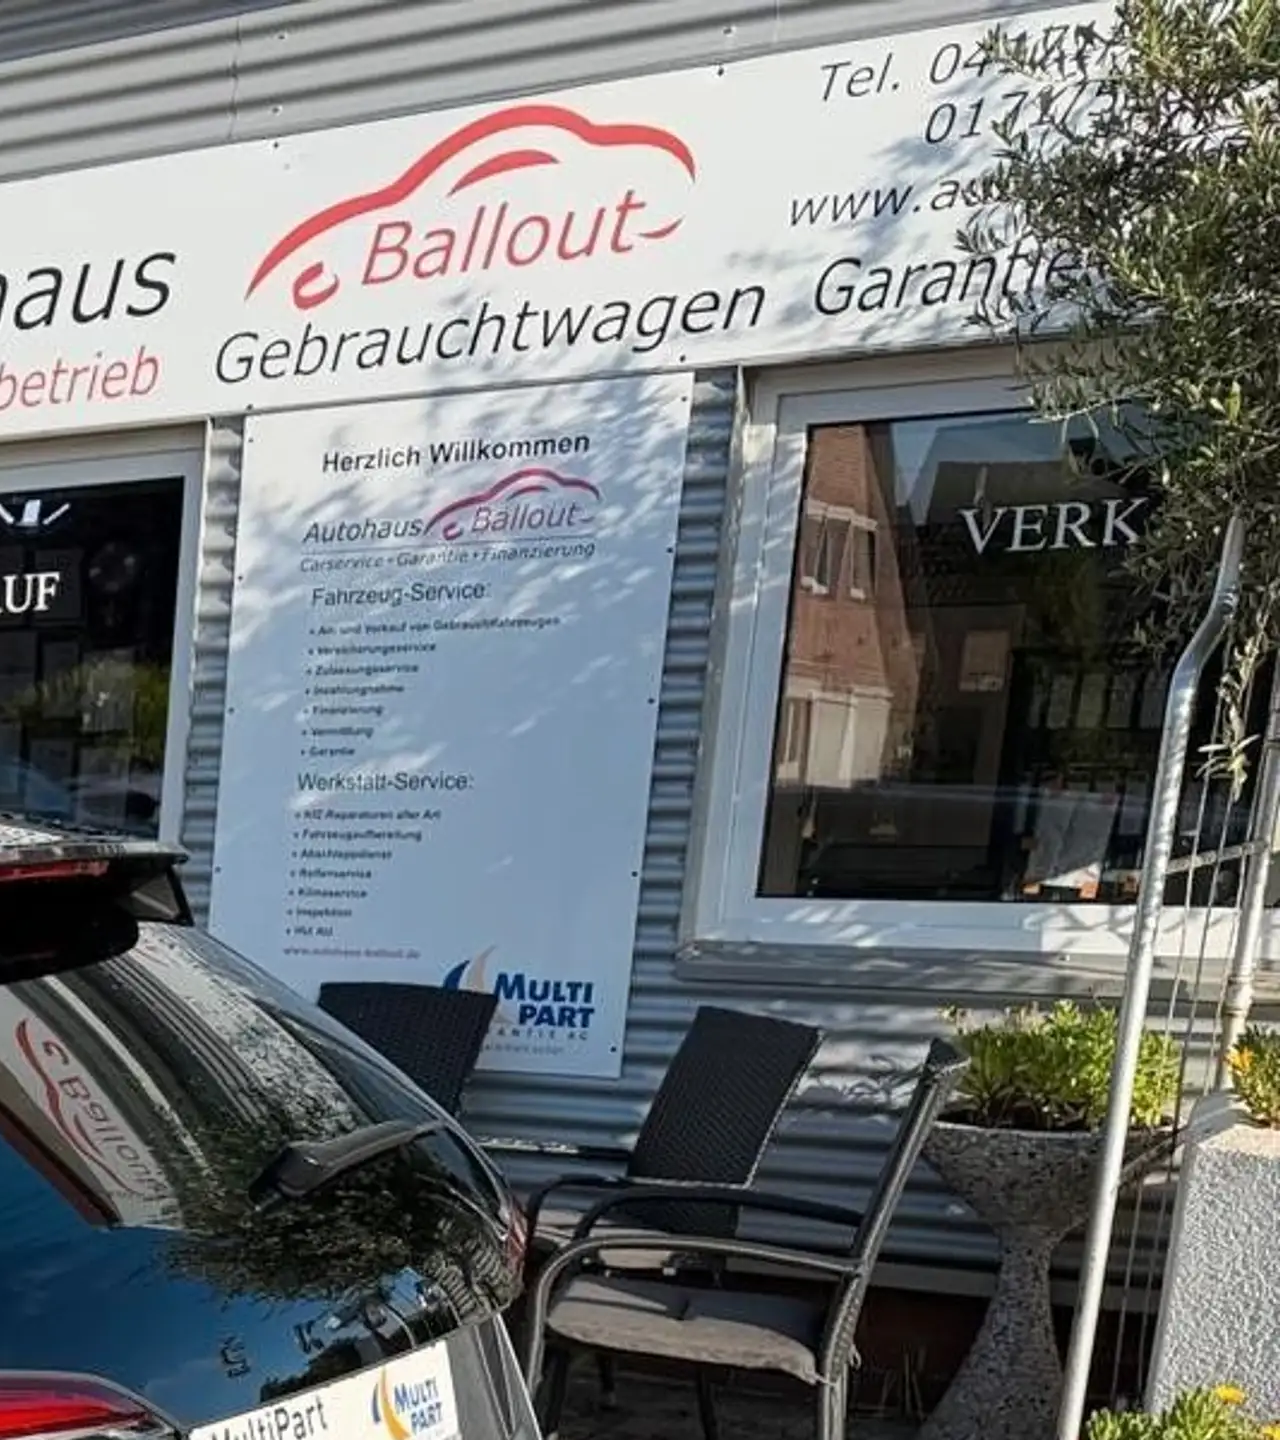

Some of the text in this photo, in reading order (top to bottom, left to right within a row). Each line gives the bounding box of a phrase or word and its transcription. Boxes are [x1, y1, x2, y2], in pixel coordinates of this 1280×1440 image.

[819, 53, 900, 102] Tel.
[362, 190, 646, 287] Ballout
[215, 284, 766, 384] Gebrauchtwagen
[321, 434, 590, 473] Herzlich Willkommen
[302, 517, 424, 544] Autohaus
[470, 502, 579, 534] Ballout
[960, 498, 1149, 555] VERK
[300, 540, 596, 573] Carservice Garantie Finanzierung
[311, 581, 492, 608] Fahrzeug-Service:
[298, 771, 474, 791] Werkstatt-Service:
[494, 972, 594, 1003] MULTI
[518, 1004, 595, 1028] PART
[394, 1376, 439, 1414] MULTI
[411, 1400, 442, 1435] PART
